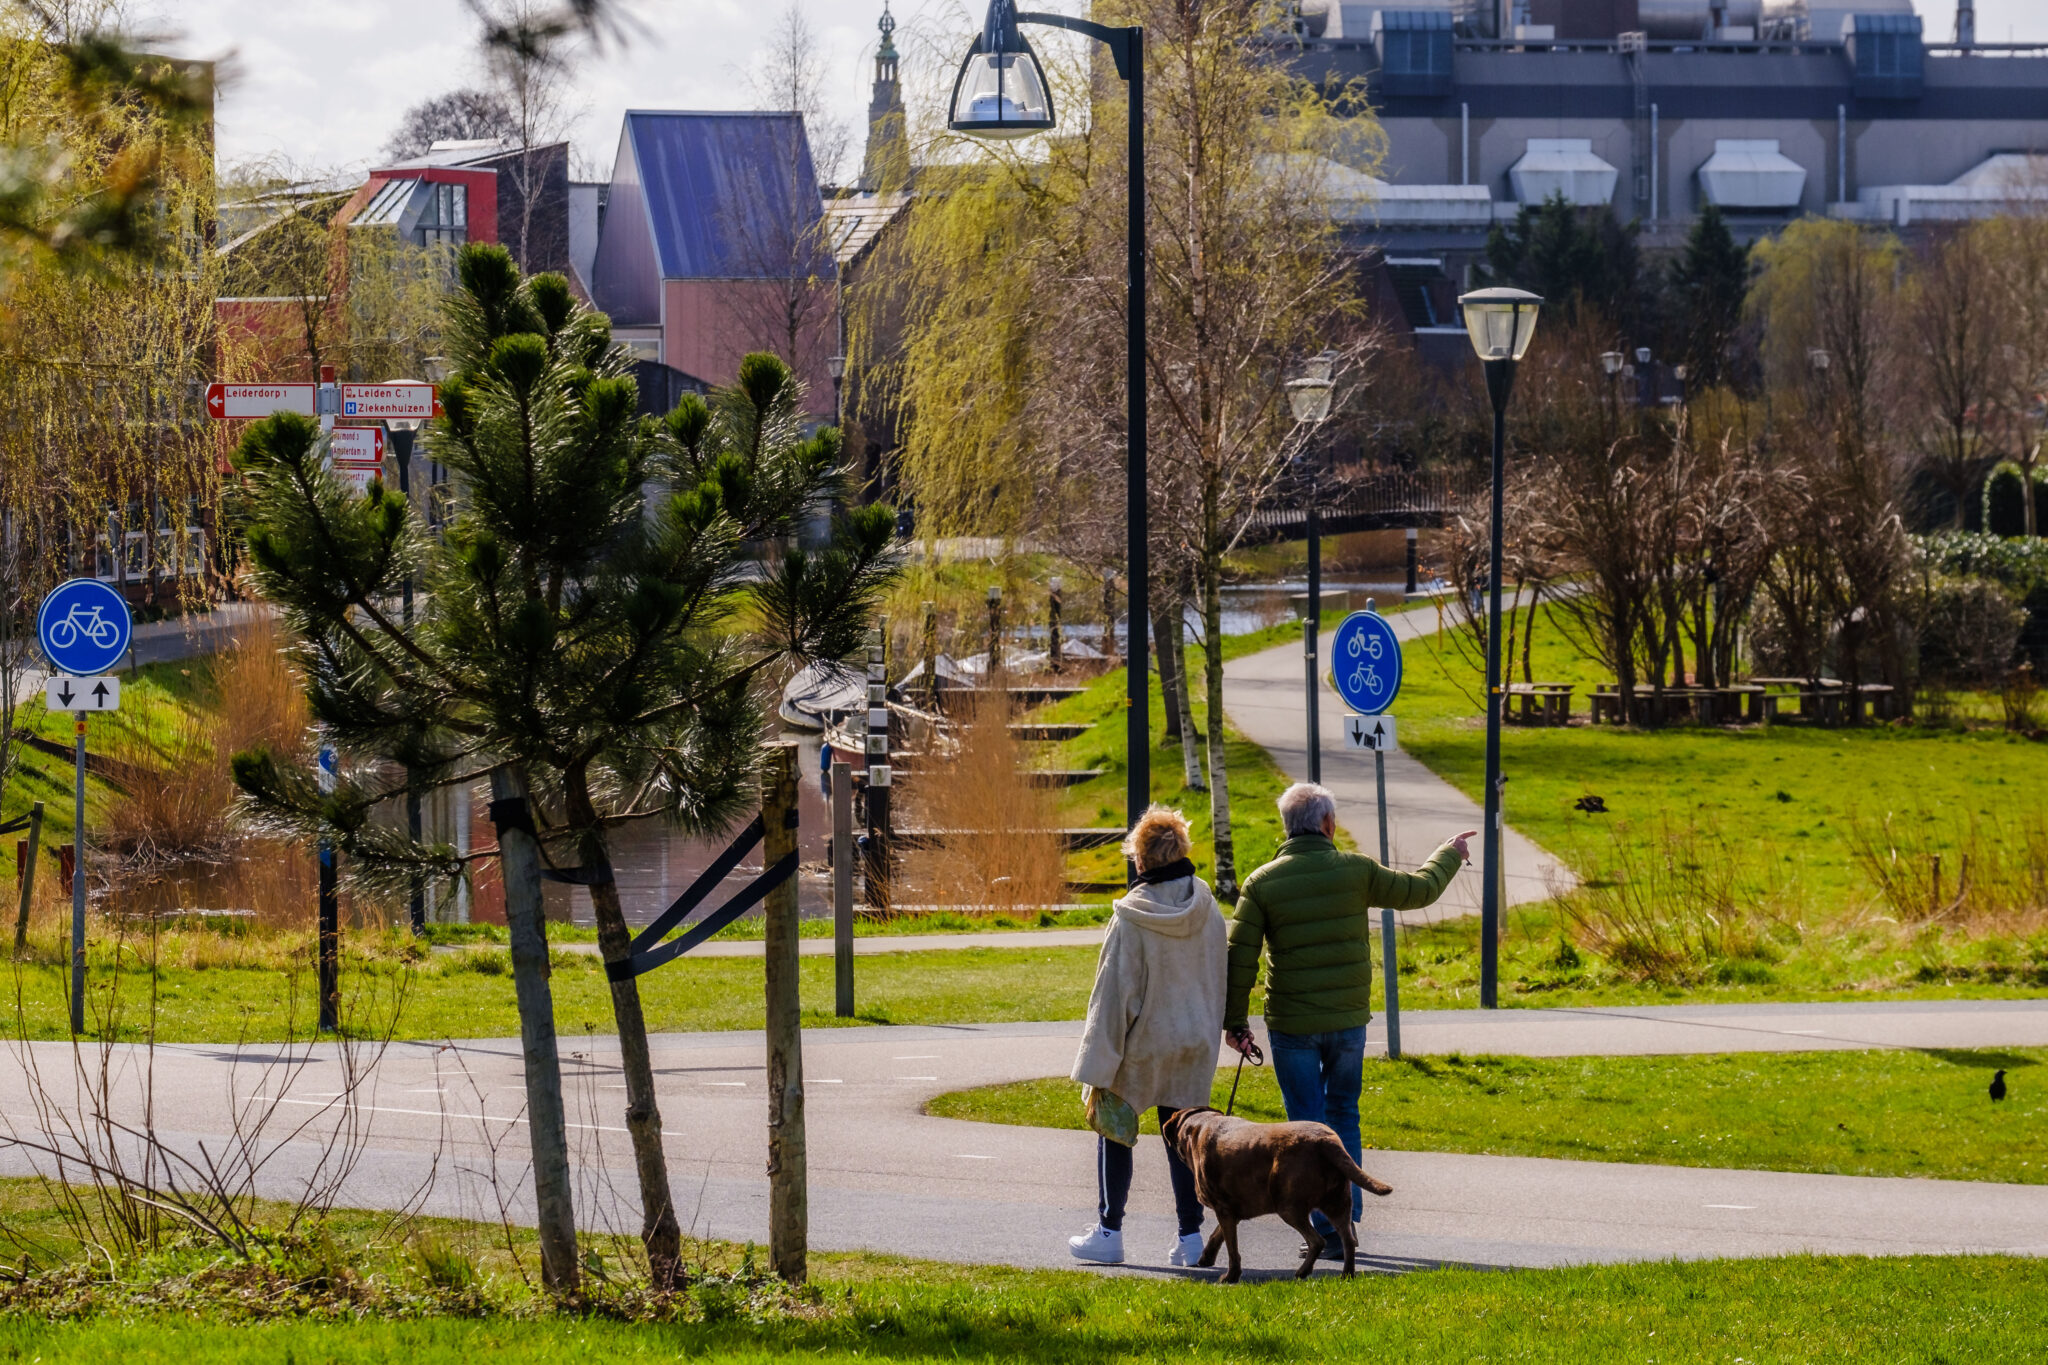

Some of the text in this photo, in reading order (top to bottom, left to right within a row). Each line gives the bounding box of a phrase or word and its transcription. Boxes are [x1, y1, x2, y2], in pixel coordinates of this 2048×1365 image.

[226, 389, 281, 399] Leiderdorp
[358, 389, 391, 397] Leiden
[395, 389, 405, 398] C.
[358, 403, 424, 412] Ziekenhuizen
[333, 432, 356, 440] armond
[333, 447, 361, 455] Amsterdam
